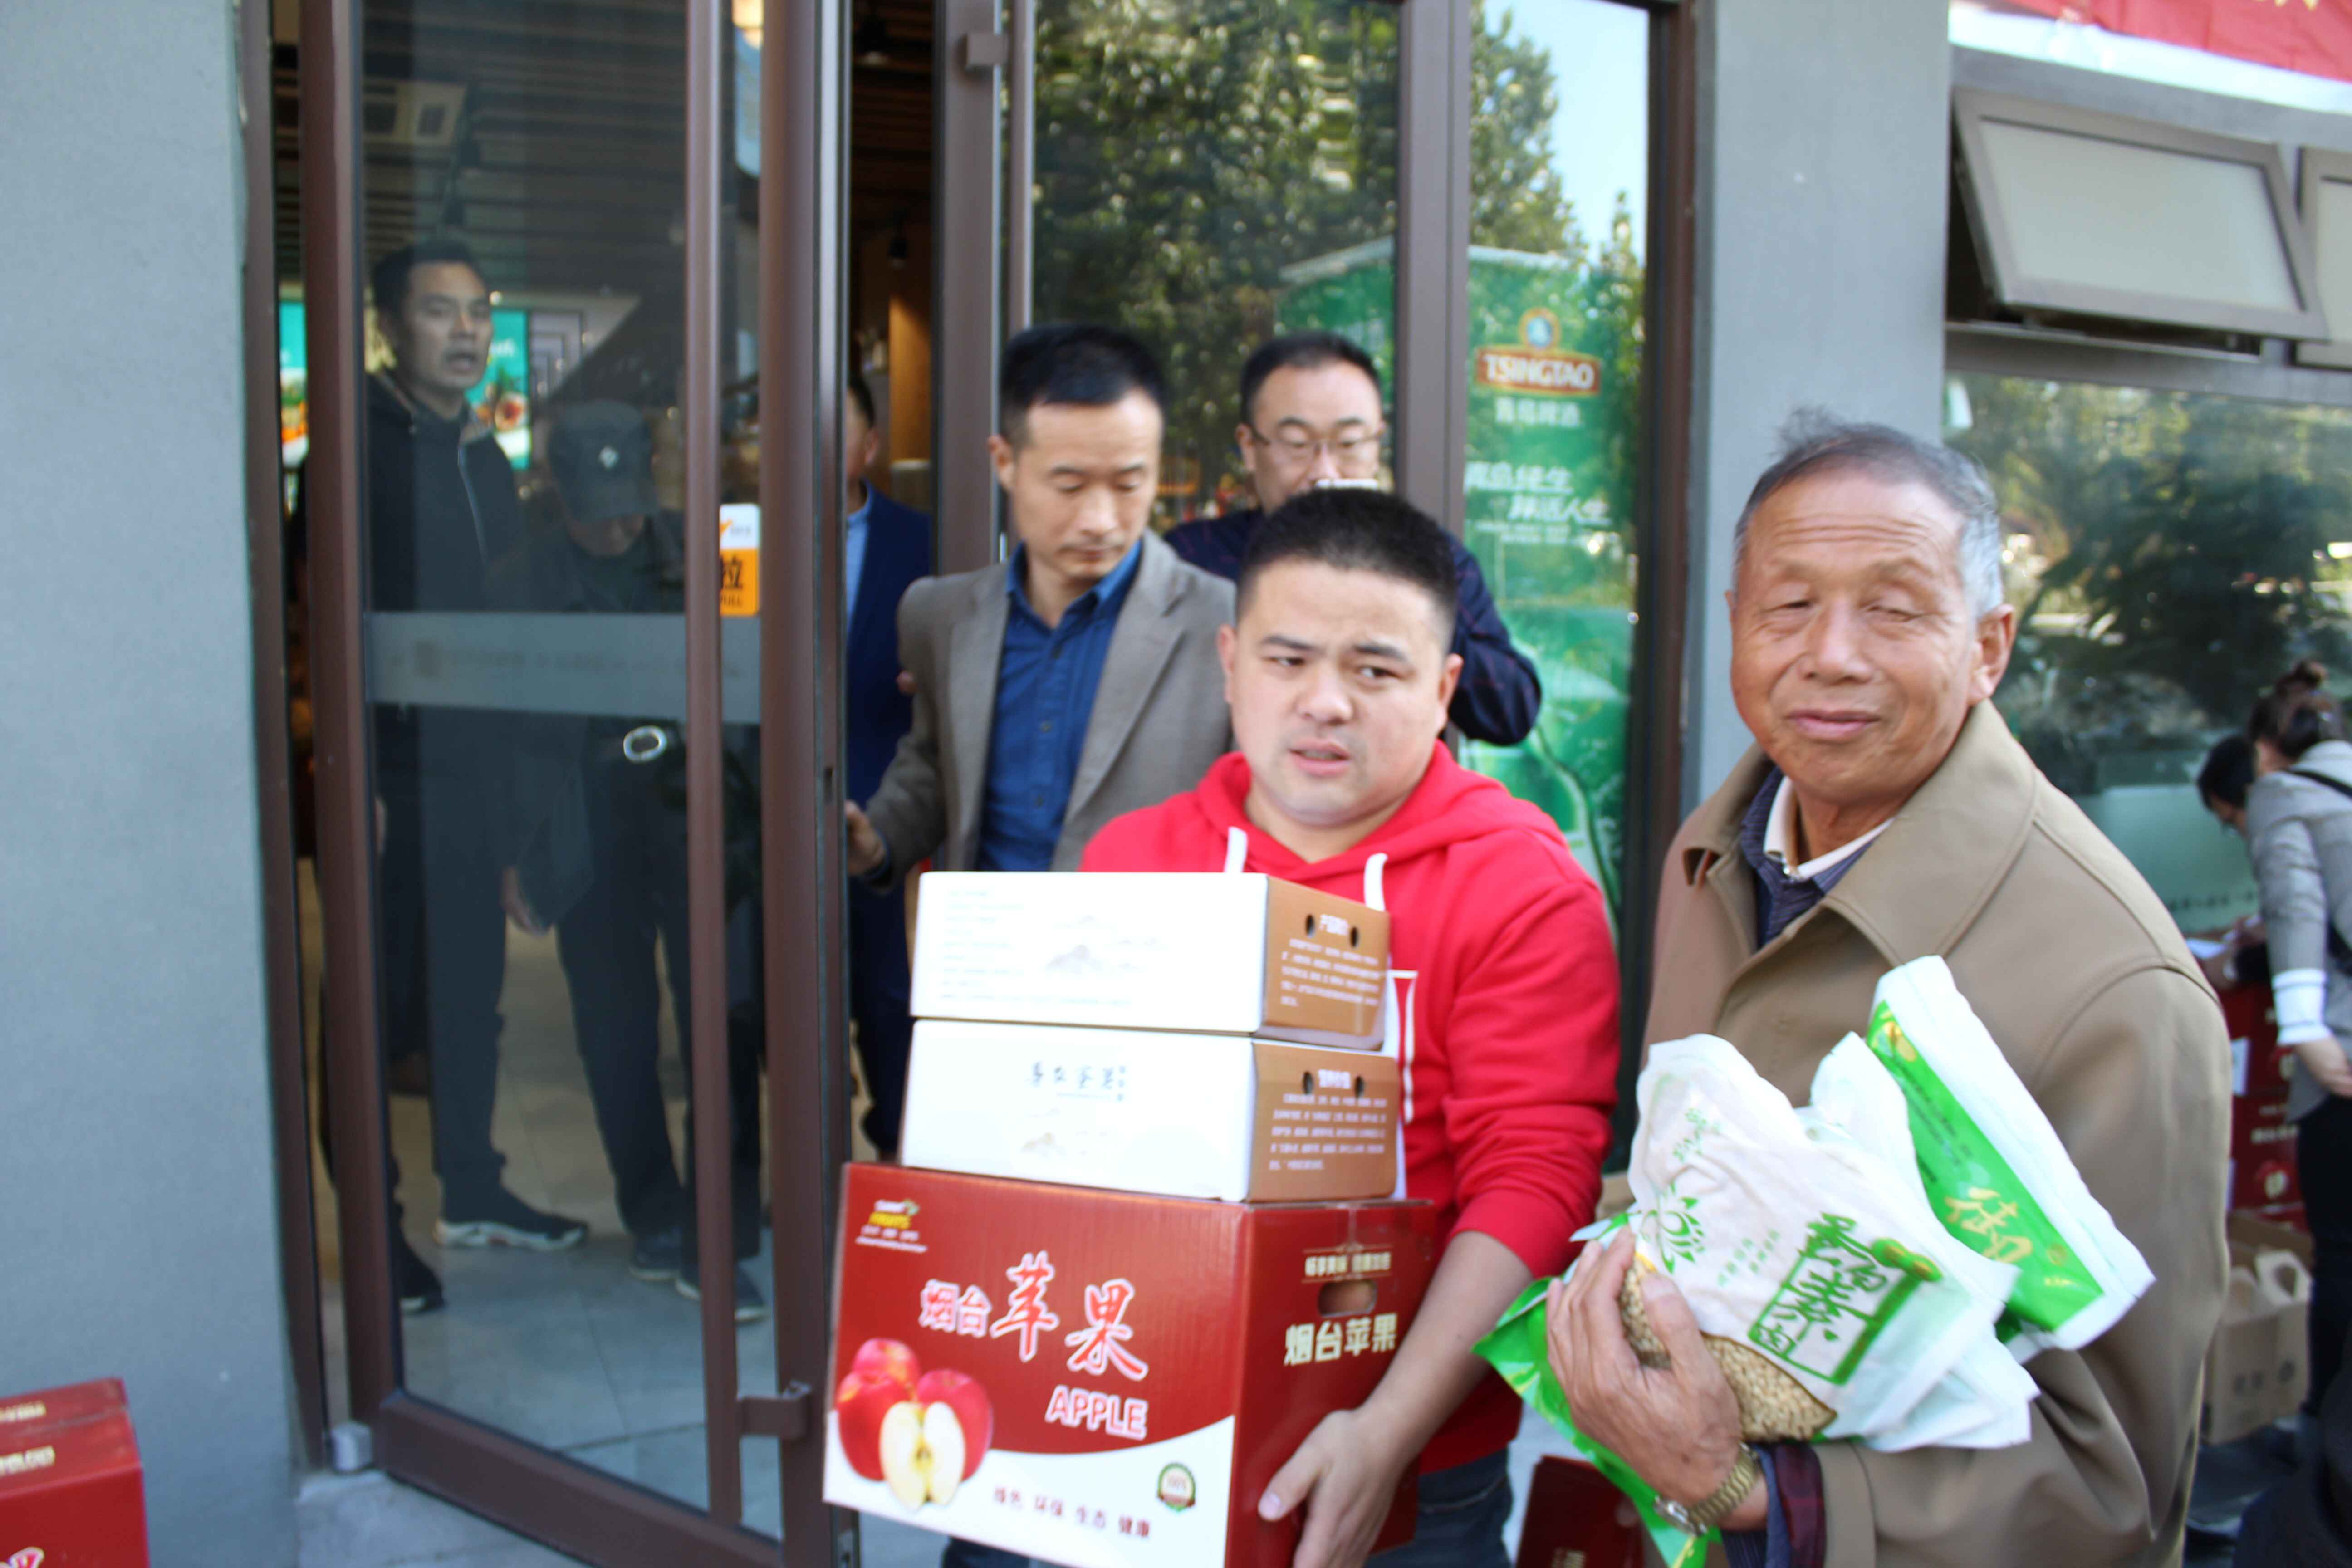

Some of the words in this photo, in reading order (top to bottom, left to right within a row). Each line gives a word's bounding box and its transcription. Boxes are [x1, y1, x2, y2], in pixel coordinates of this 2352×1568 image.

[1484, 354, 1594, 389] TSINGTAO
[919, 1251, 1148, 1380] 烟台苹果
[1284, 1313, 1397, 1366] 烟台苹果
[1044, 1385, 1149, 1440] APPLE
